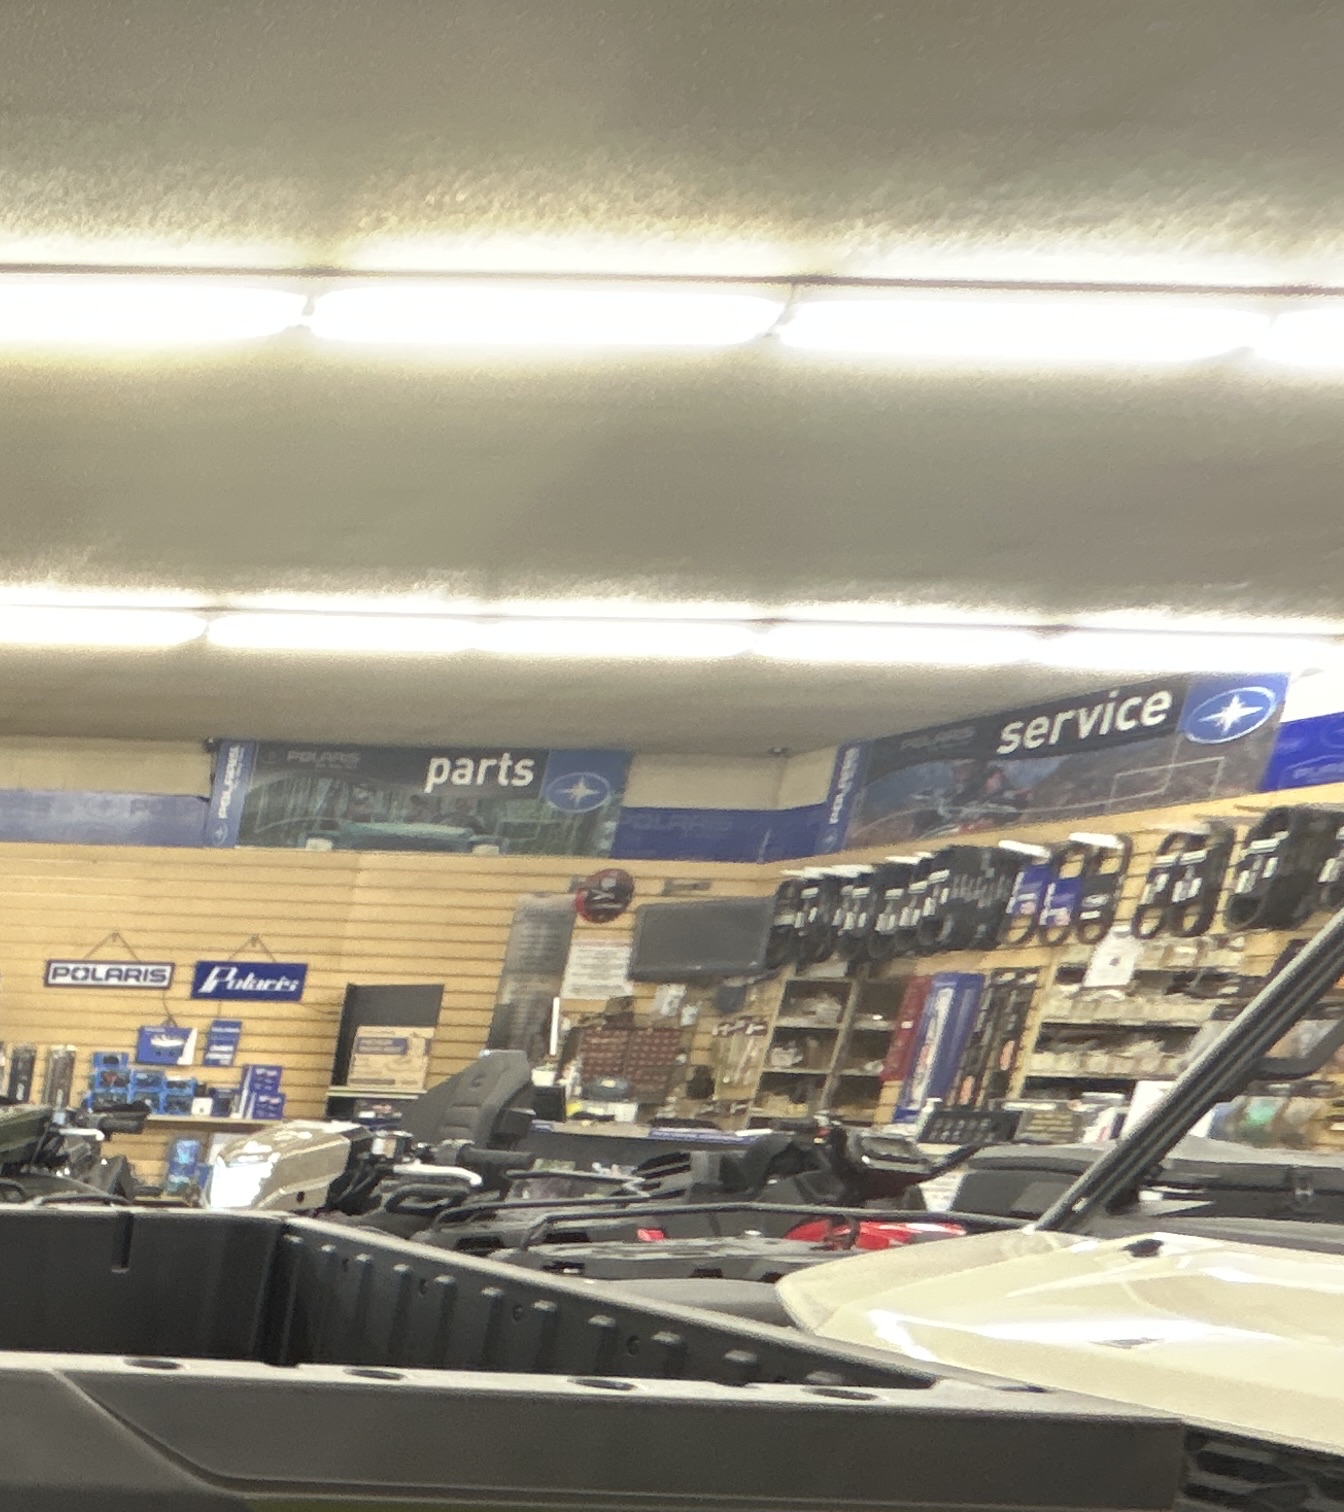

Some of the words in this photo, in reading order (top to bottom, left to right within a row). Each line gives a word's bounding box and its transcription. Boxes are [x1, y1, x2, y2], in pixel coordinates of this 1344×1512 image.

[996, 690, 1172, 754] service
[423, 753, 535, 793] parts
[51, 966, 167, 983] POLARIS
